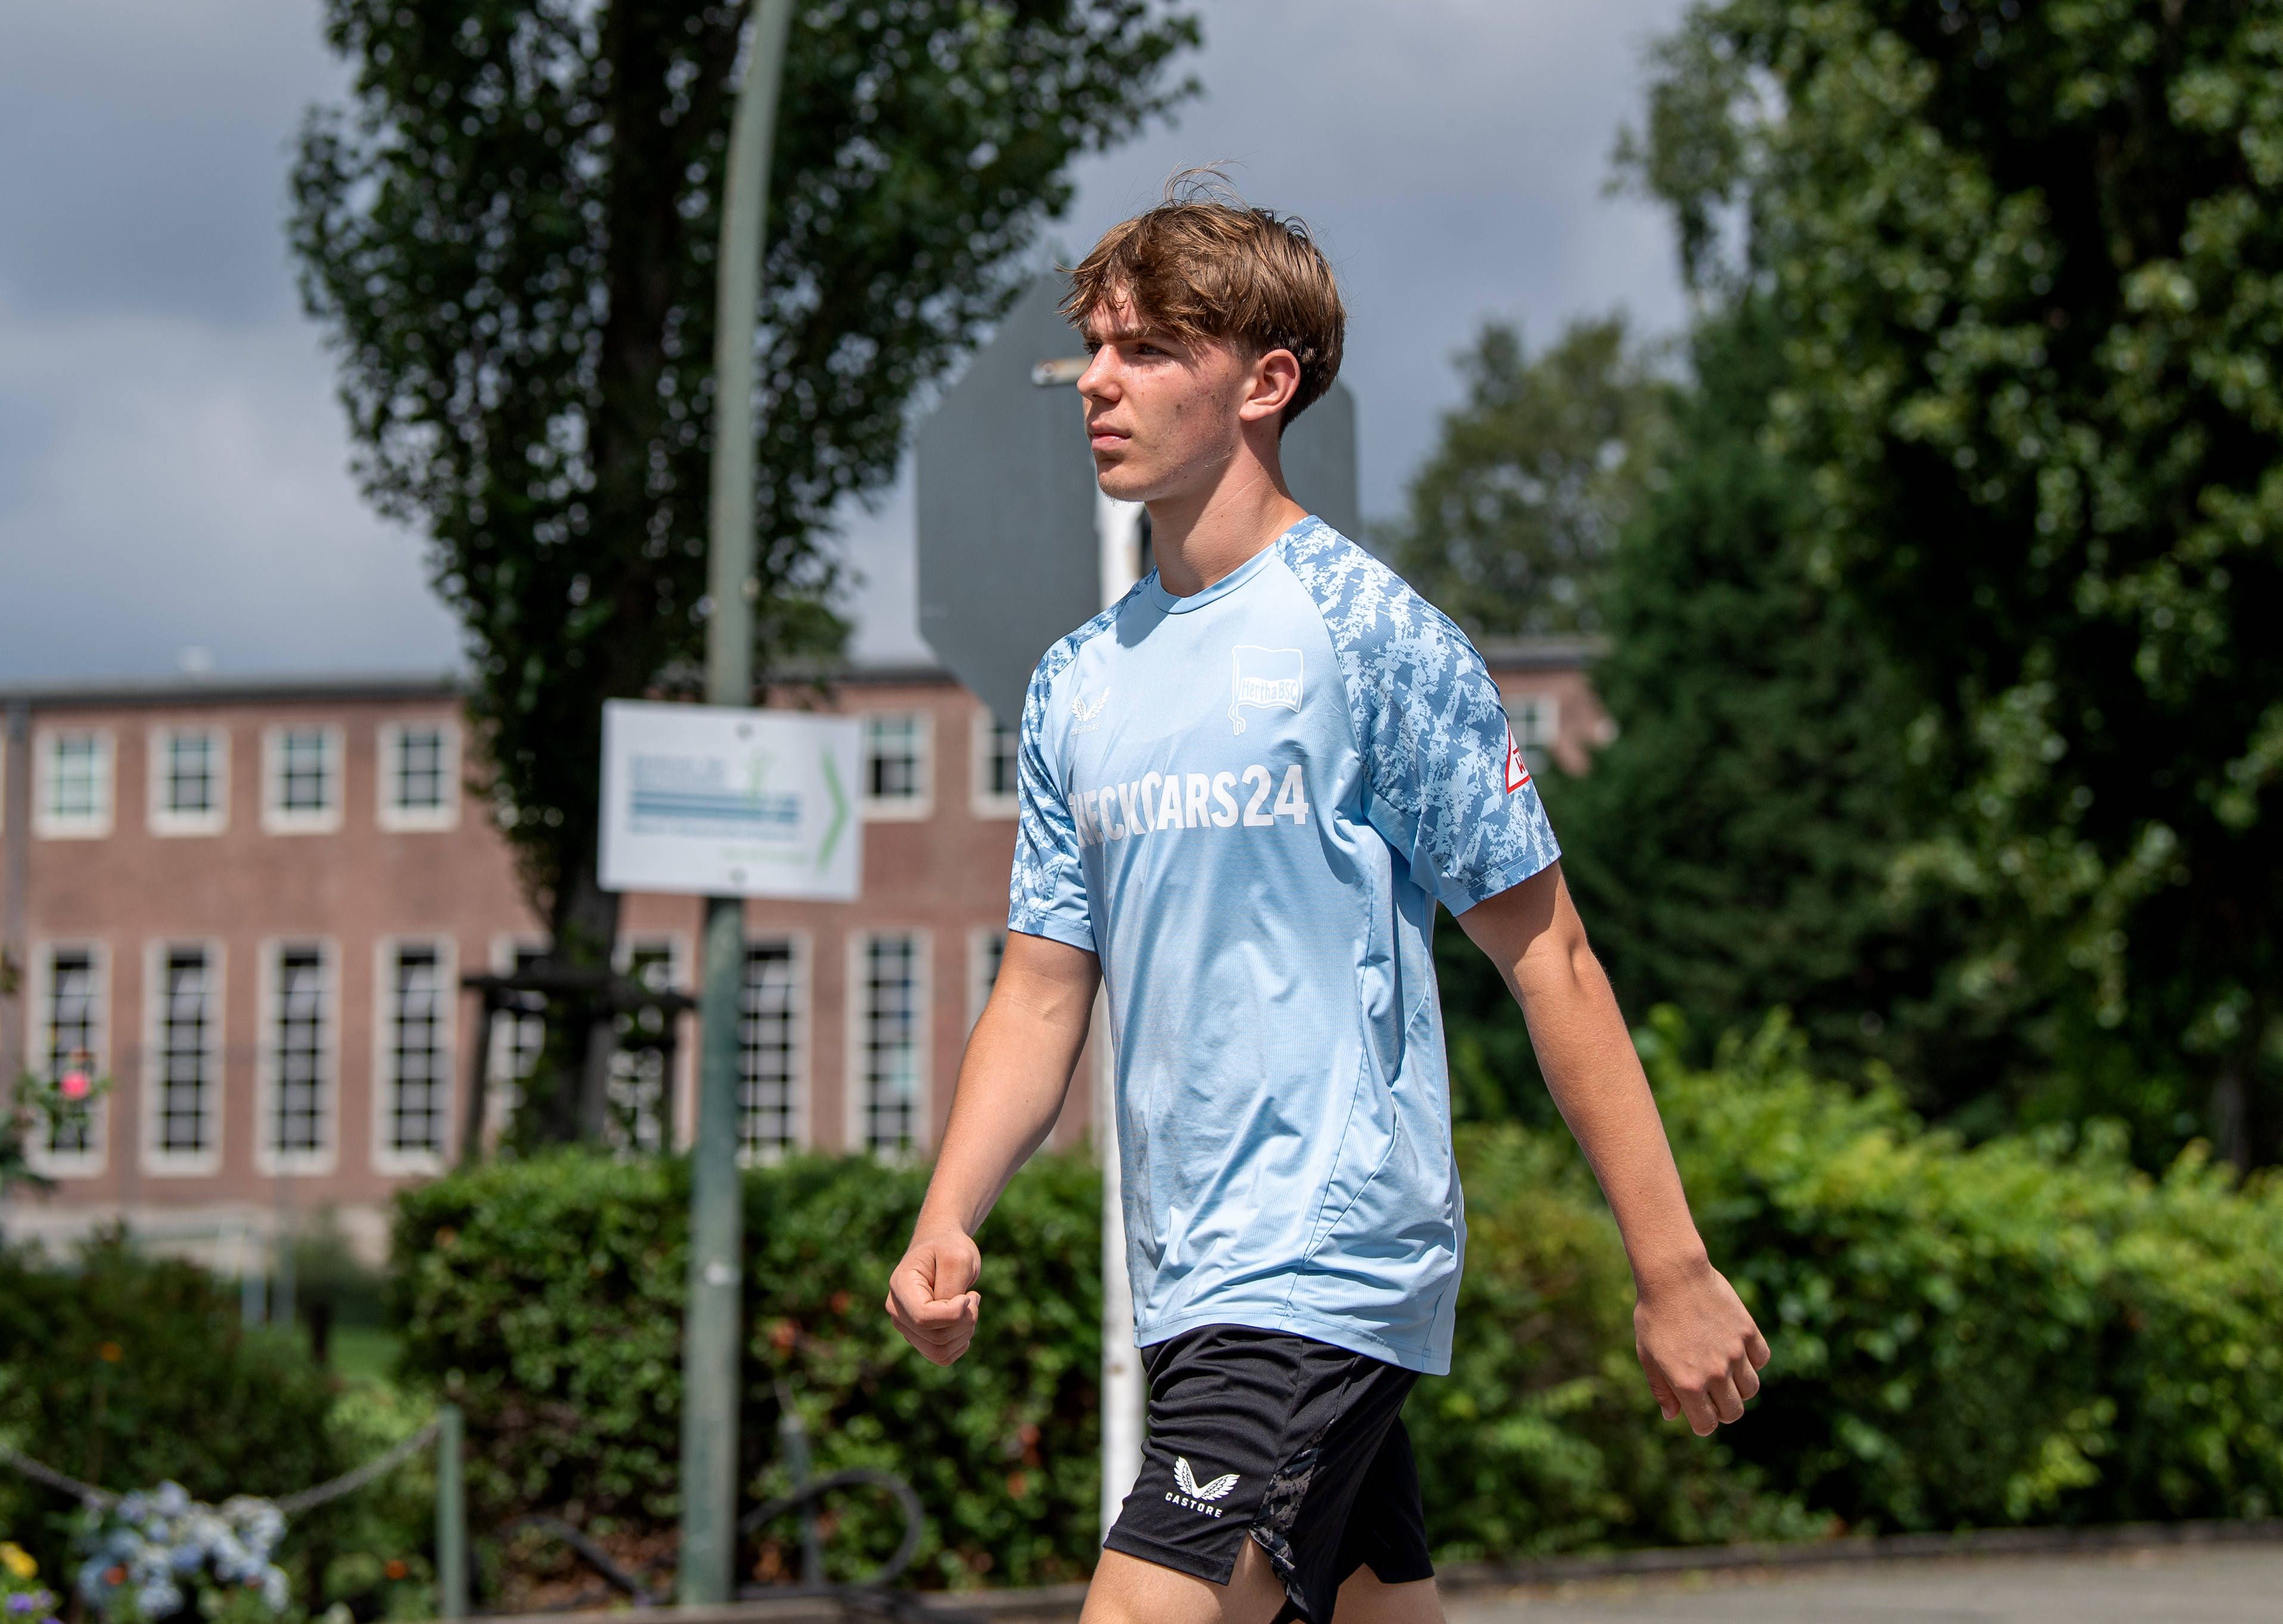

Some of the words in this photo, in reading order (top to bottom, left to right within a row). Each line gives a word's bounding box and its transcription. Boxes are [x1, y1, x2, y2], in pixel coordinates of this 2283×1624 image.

[1241, 680, 1276, 701] Hertha
[1278, 682, 1297, 702] BSC
[1165, 1492, 1222, 1518] CASTORE
